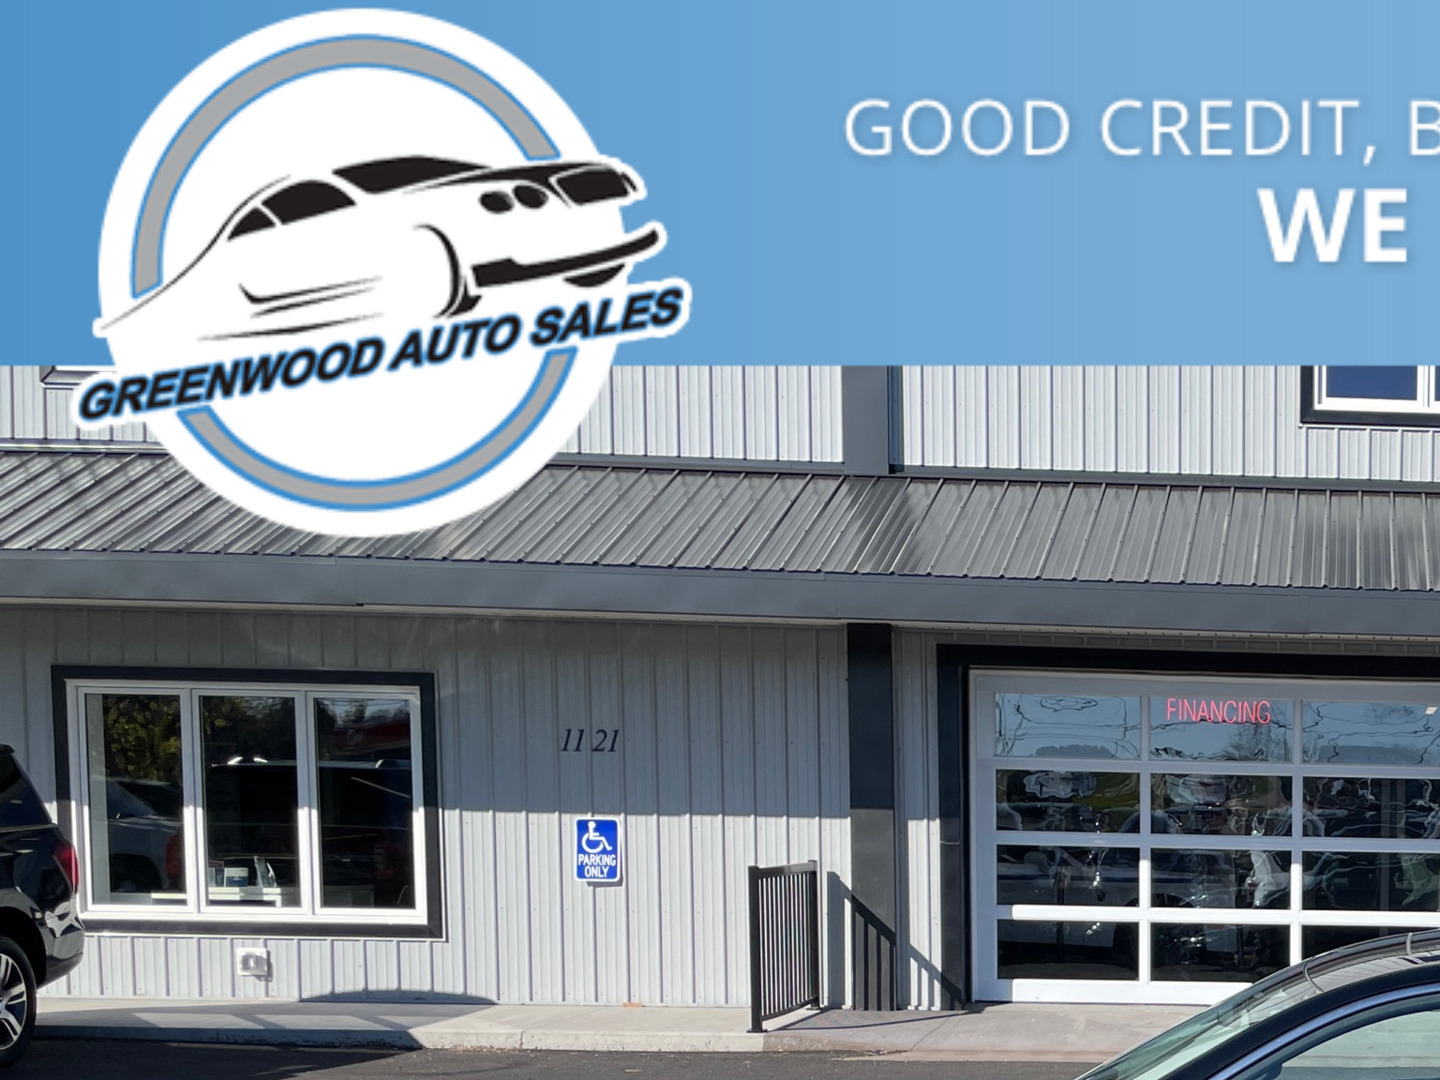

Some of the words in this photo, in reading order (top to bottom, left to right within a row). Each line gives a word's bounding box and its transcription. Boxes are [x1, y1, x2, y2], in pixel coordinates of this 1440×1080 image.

[1166, 698, 1271, 724] FINANCING
[578, 854, 617, 867] PARKING
[584, 866, 610, 878] ONLY
